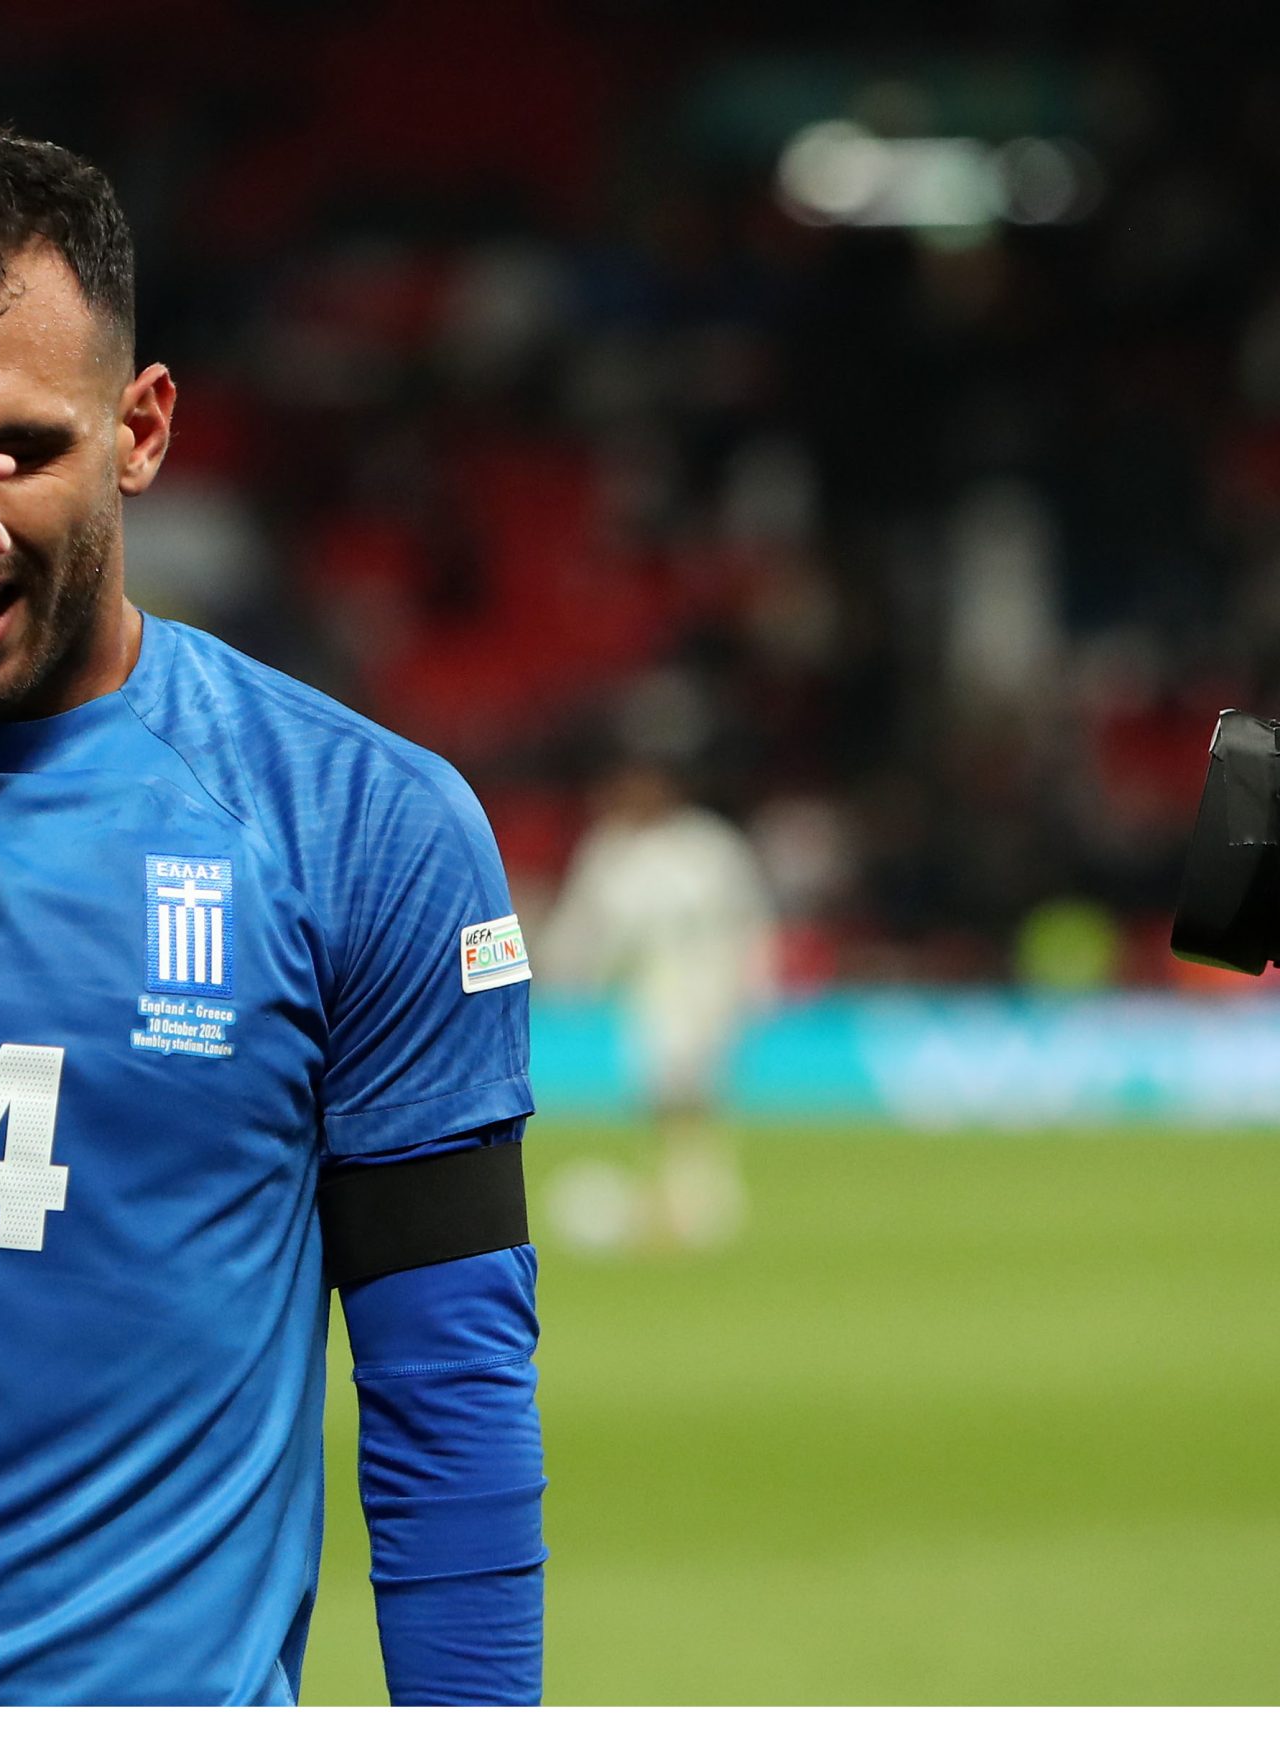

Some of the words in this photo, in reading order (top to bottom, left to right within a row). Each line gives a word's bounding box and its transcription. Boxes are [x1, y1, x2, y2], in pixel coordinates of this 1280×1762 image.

[156, 862, 222, 880] ΕΛΛΑΣ
[465, 928, 492, 946] UEFA
[140, 999, 185, 1016] England
[196, 1004, 233, 1022] Greece
[149, 1019, 160, 1033] 10
[161, 1020, 198, 1037] October
[199, 1023, 222, 1040] 2024
[133, 1032, 170, 1053] Wembley
[172, 1036, 204, 1052] stadium
